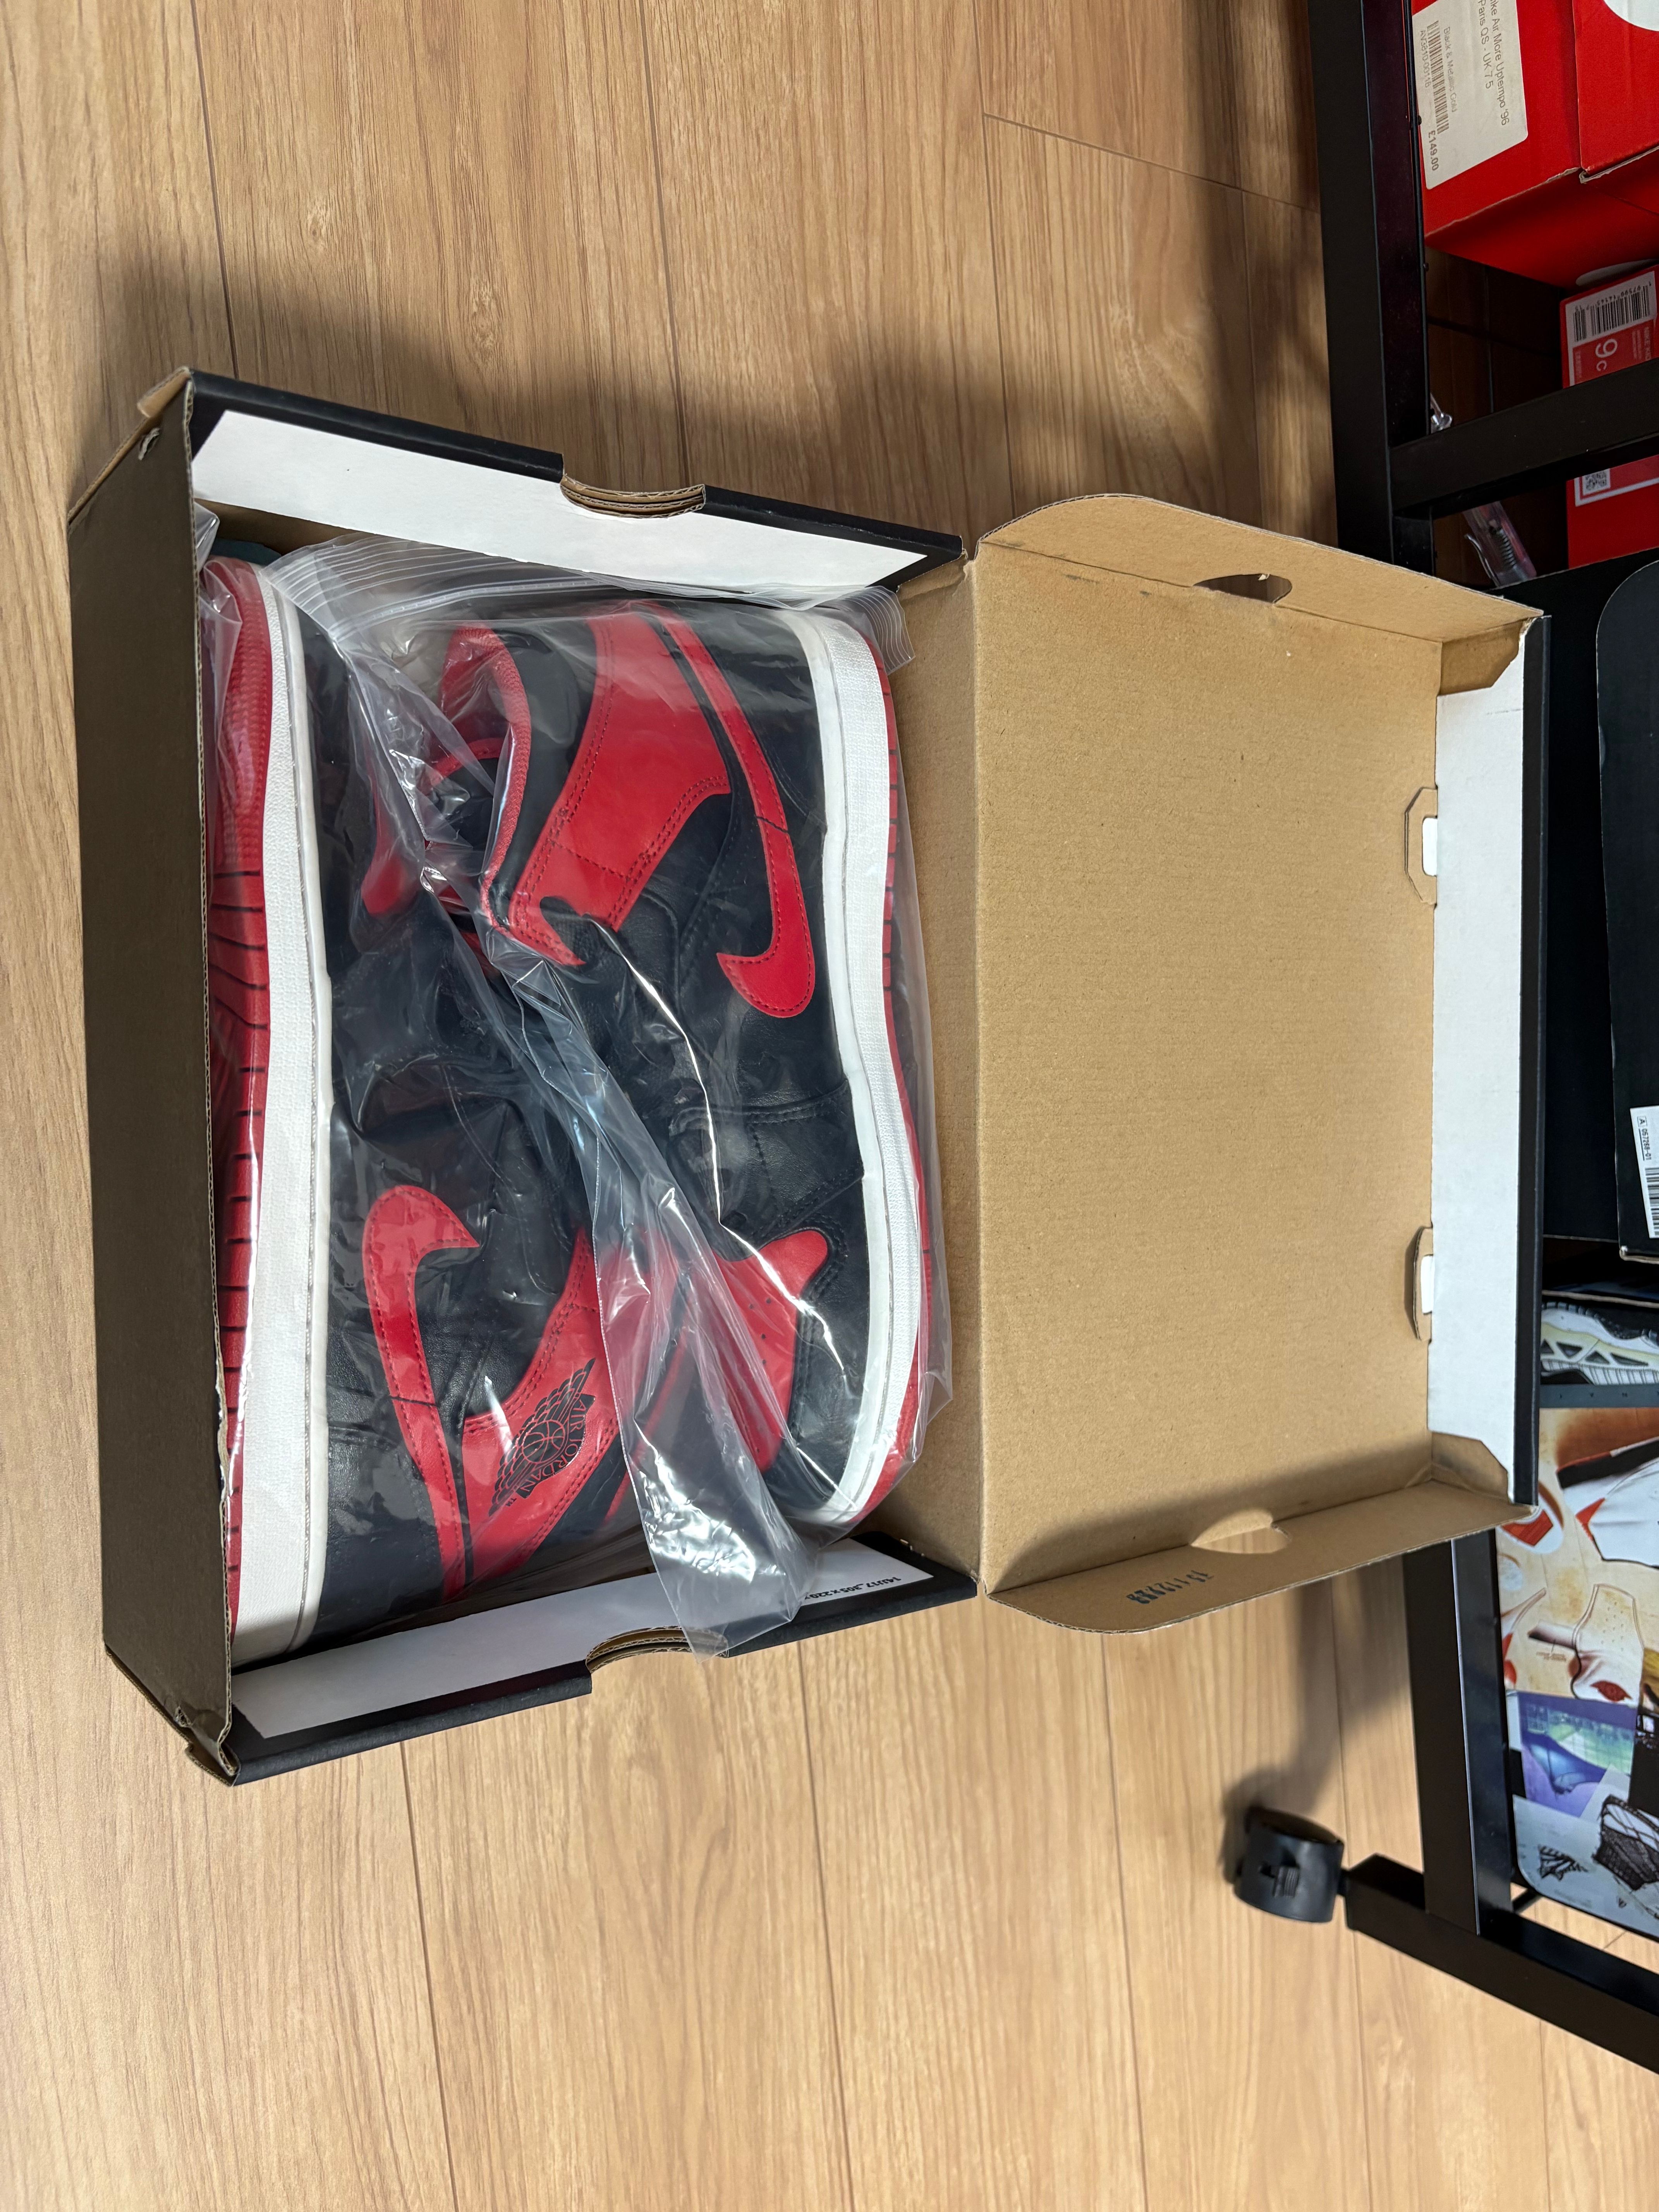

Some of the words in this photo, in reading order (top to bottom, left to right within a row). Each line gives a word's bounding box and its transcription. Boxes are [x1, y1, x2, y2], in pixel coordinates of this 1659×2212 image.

[1478, 0, 1486, 26] Paris
[1490, 0, 1499, 15] ike
[1443, 26, 1451, 51] Black
[1480, 27, 1489, 45] QS
[1493, 33, 1502, 61] More
[1483, 53, 1492, 71] UK
[1447, 60, 1456, 91] Metallic
[1494, 62, 1507, 108] Uptempo
[1449, 93, 1458, 112] Gold
[1501, 109, 1510, 126] '96
[1428, 130, 1439, 171] £149.00
[569, 1400, 587, 1433] AIR
[520, 1437, 582, 1492] JORDAN
